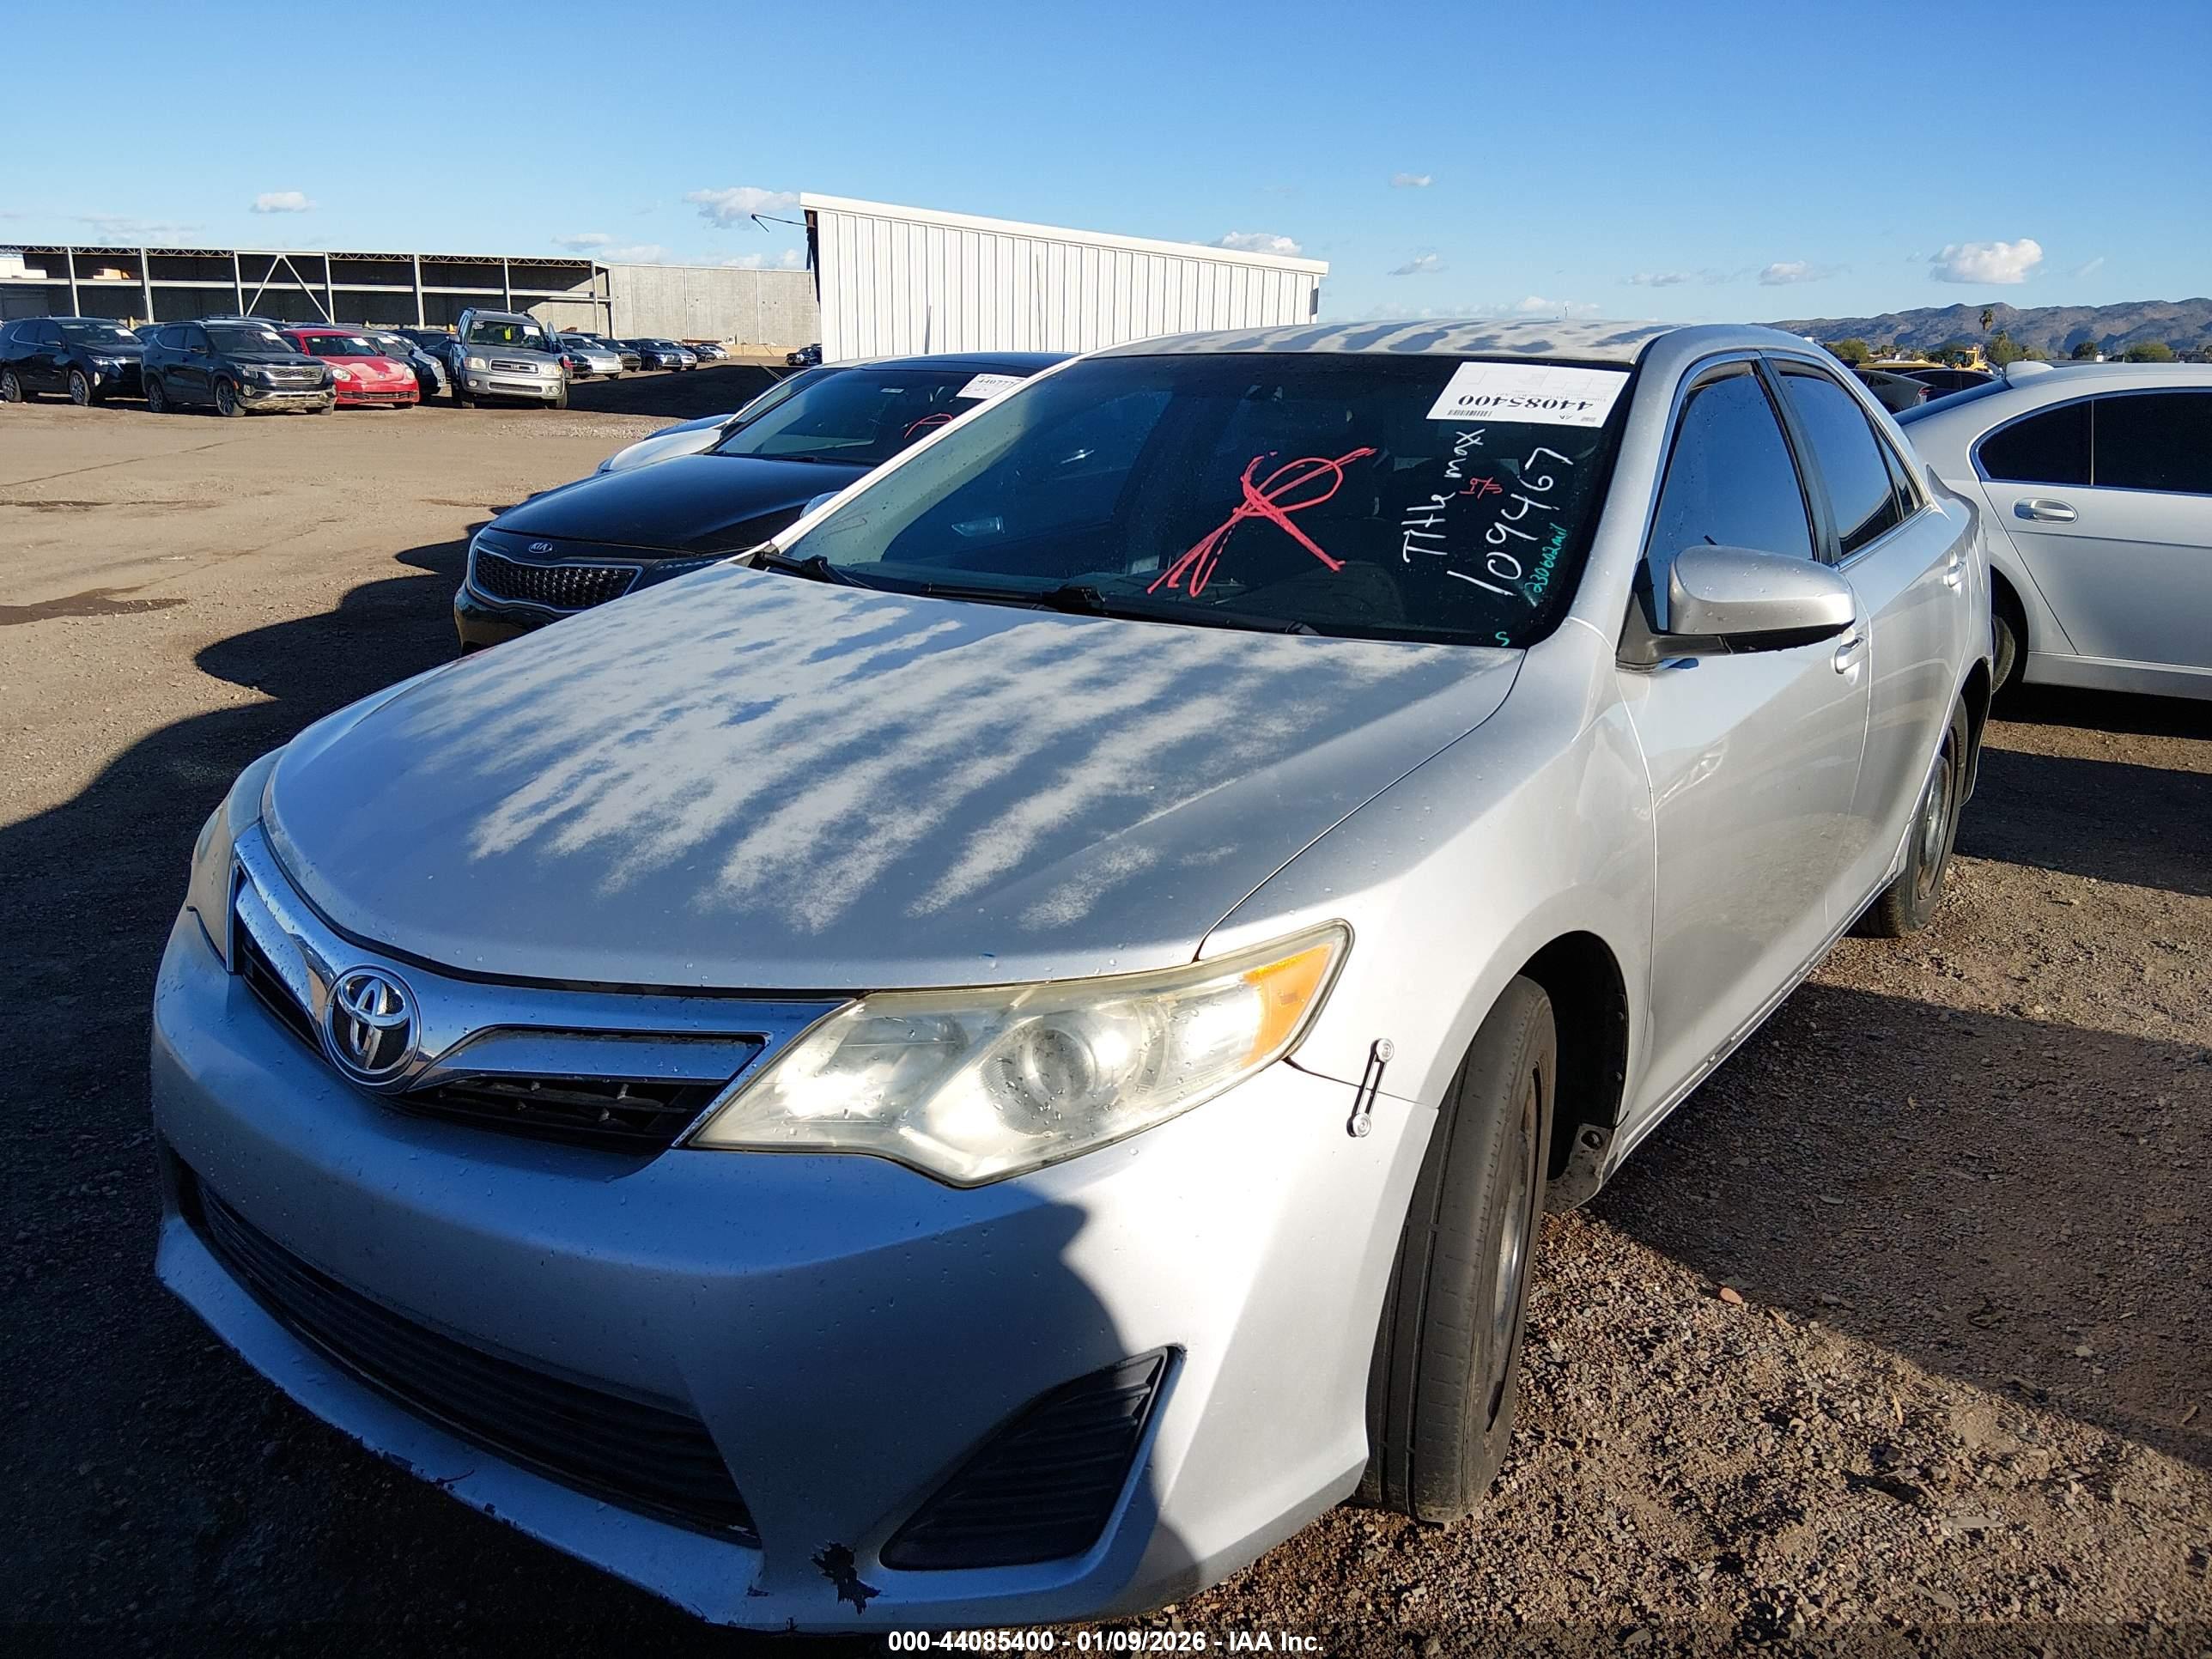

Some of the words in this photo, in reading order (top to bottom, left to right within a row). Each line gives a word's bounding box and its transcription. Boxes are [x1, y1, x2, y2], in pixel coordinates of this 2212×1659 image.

[1457, 394, 1594, 411] 44085400
[1446, 447, 1574, 597] 109467
[529, 542, 549, 551] KIA
